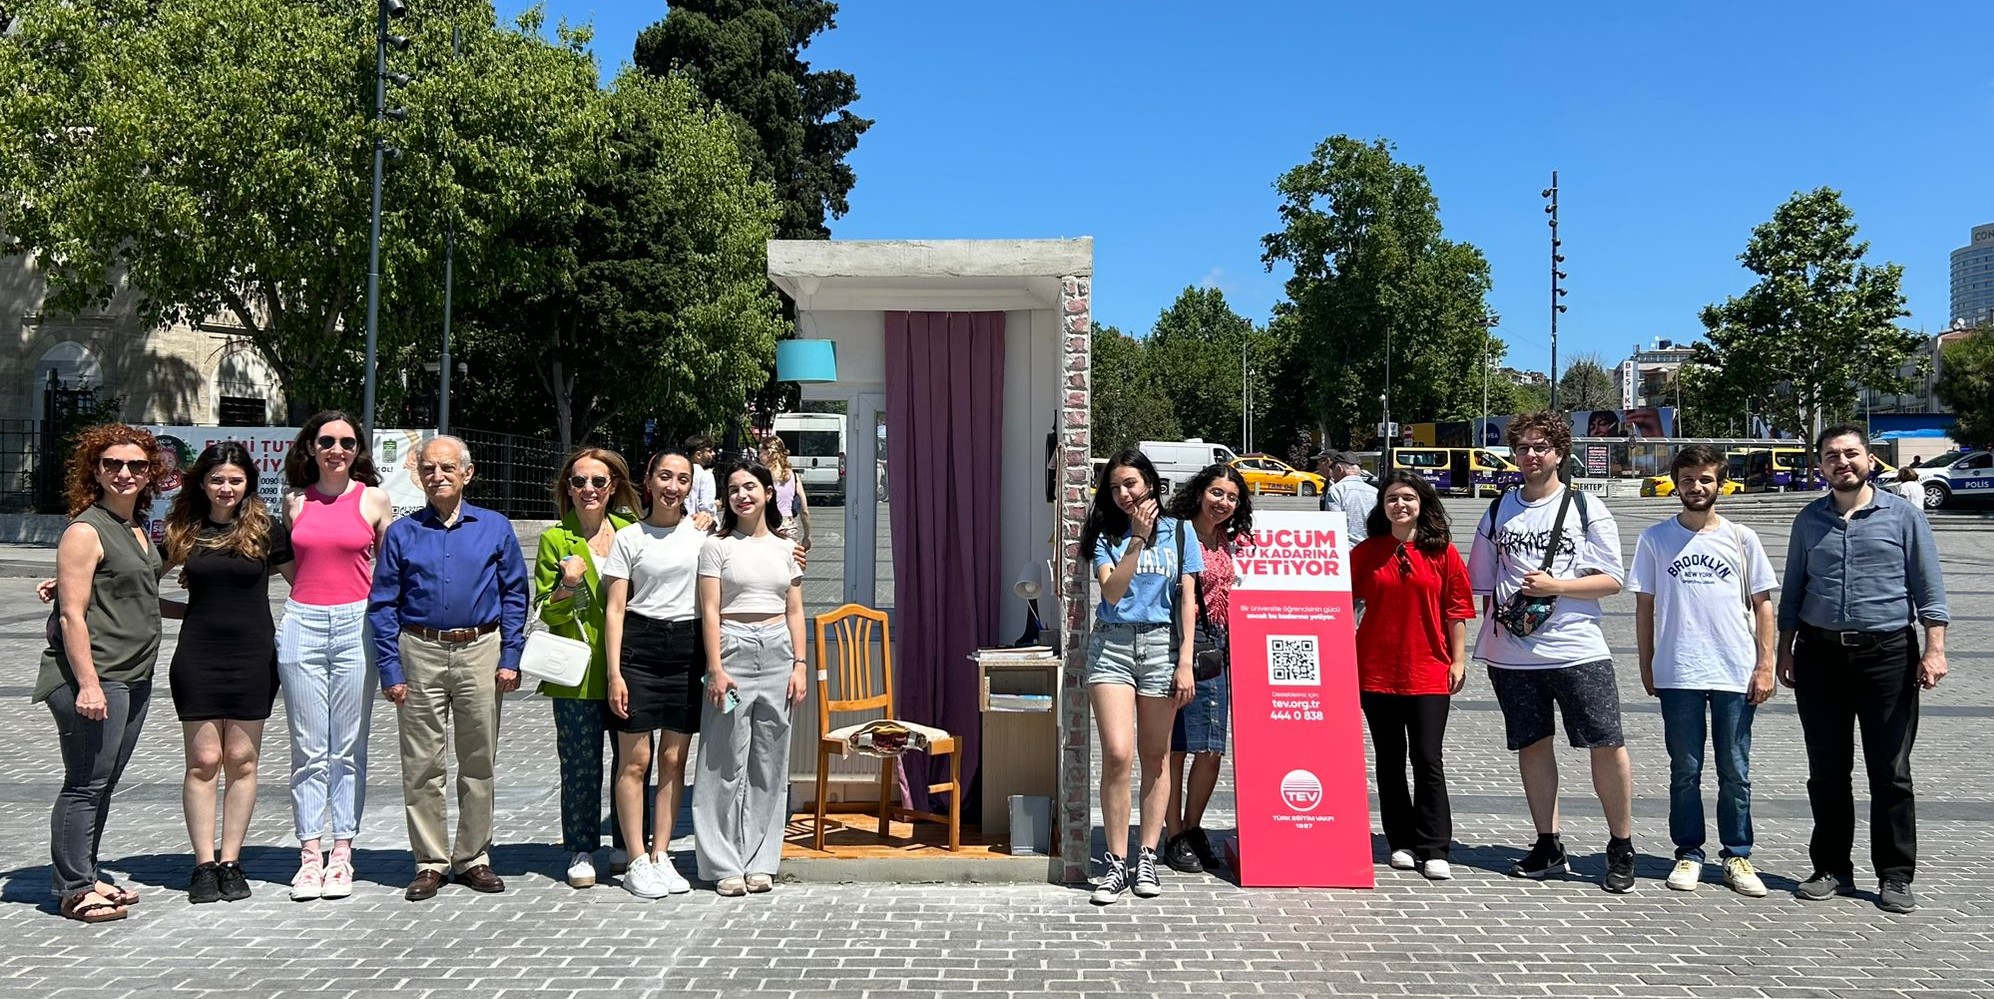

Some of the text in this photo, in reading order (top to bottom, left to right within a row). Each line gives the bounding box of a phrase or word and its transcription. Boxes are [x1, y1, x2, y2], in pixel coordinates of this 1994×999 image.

[1965, 480, 1990, 489] POLİS
[1260, 549, 1339, 559] KADARINA
[1236, 559, 1340, 576] YETİYOR
[1667, 554, 1732, 579] BROOKLYN
[1271, 699, 1320, 711] tev.org.tr
[1270, 710, 1324, 721] 444 0 838
[1285, 791, 1319, 802] TEV
